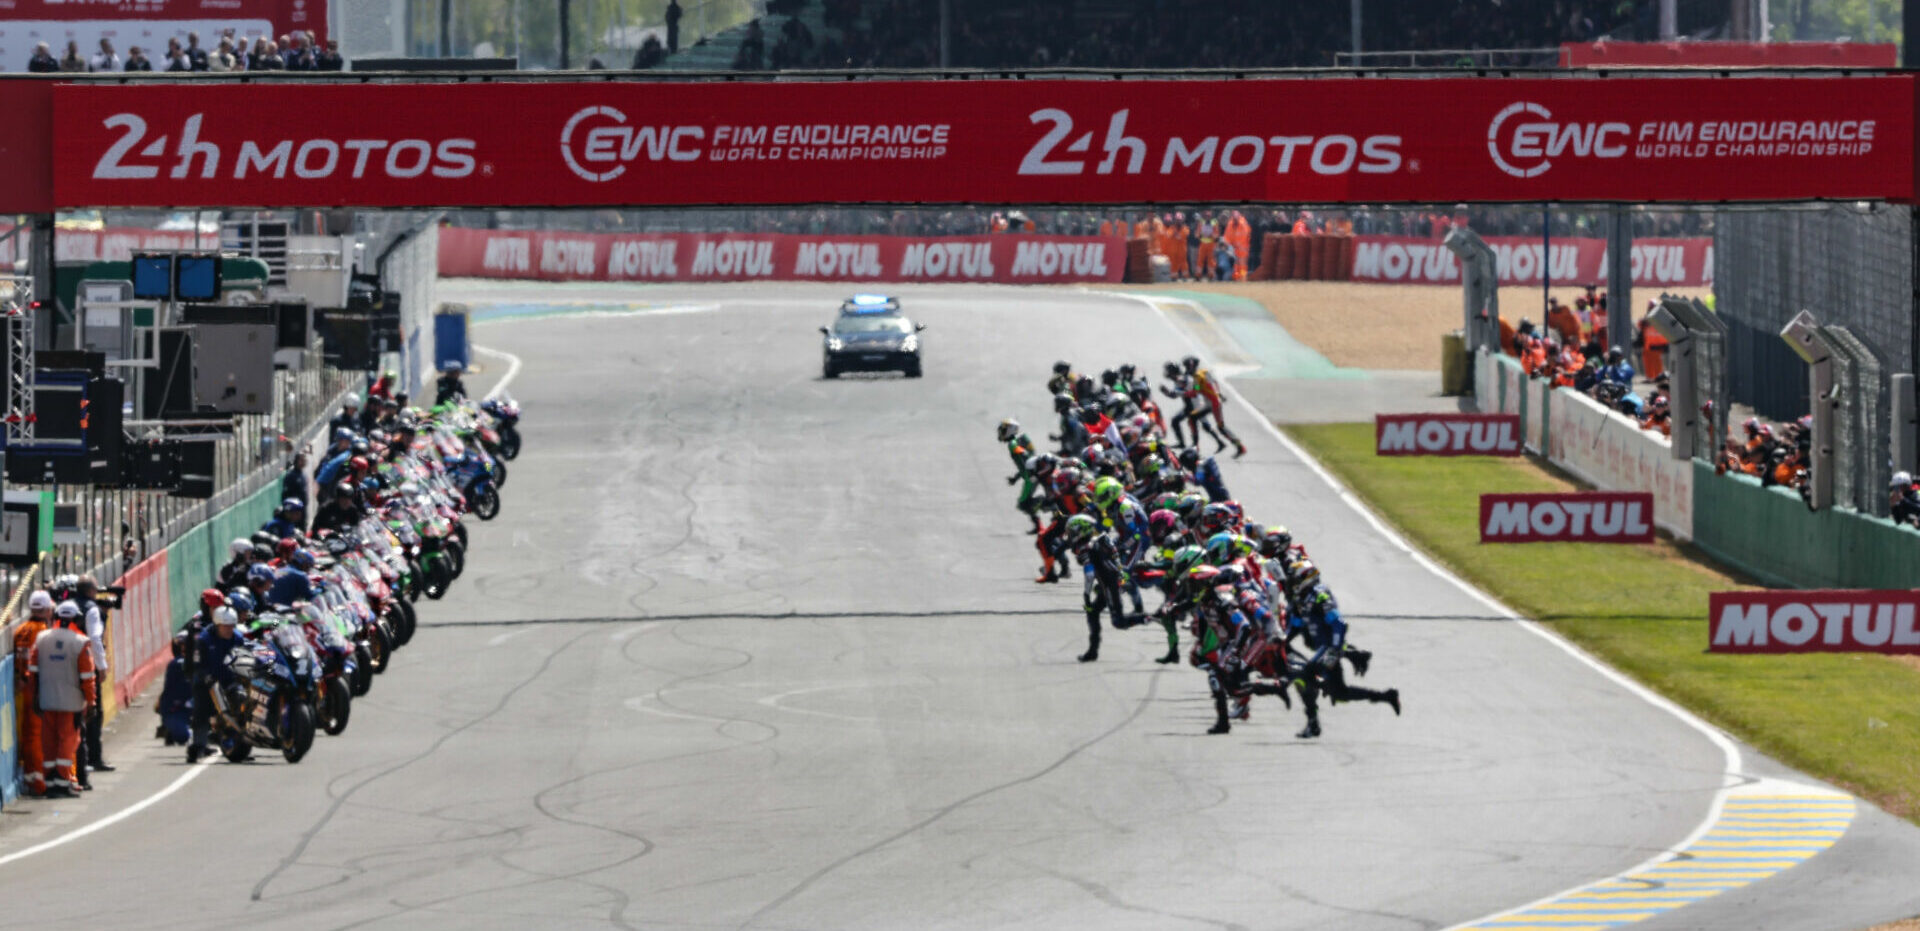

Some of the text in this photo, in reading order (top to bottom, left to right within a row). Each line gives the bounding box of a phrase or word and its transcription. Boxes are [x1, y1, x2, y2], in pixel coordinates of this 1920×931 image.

[93, 113, 477, 179] 24h MOTOS
[584, 125, 705, 162] EWC
[712, 124, 951, 146] FIM ENDURANCE
[1017, 108, 1402, 174] 24h MOTOS
[1511, 122, 1631, 158] EWC
[1638, 121, 1876, 142] FIM ENDURANCE
[709, 146, 948, 161] WORLD CHAMPIONSHIP
[1635, 142, 1873, 158] WORLD CHAMPIONSHIP
[608, 240, 678, 276] MOTUL
[691, 240, 775, 276] MOTUL
[794, 242, 883, 276] MOTUL
[899, 241, 995, 277] MOTUL
[1010, 241, 1108, 276] MOTUL
[1353, 242, 1459, 280] MOTUL
[1379, 420, 1518, 451] MOTUL
[1485, 501, 1650, 536] MOTUL
[1712, 602, 1920, 646] MOTUL
